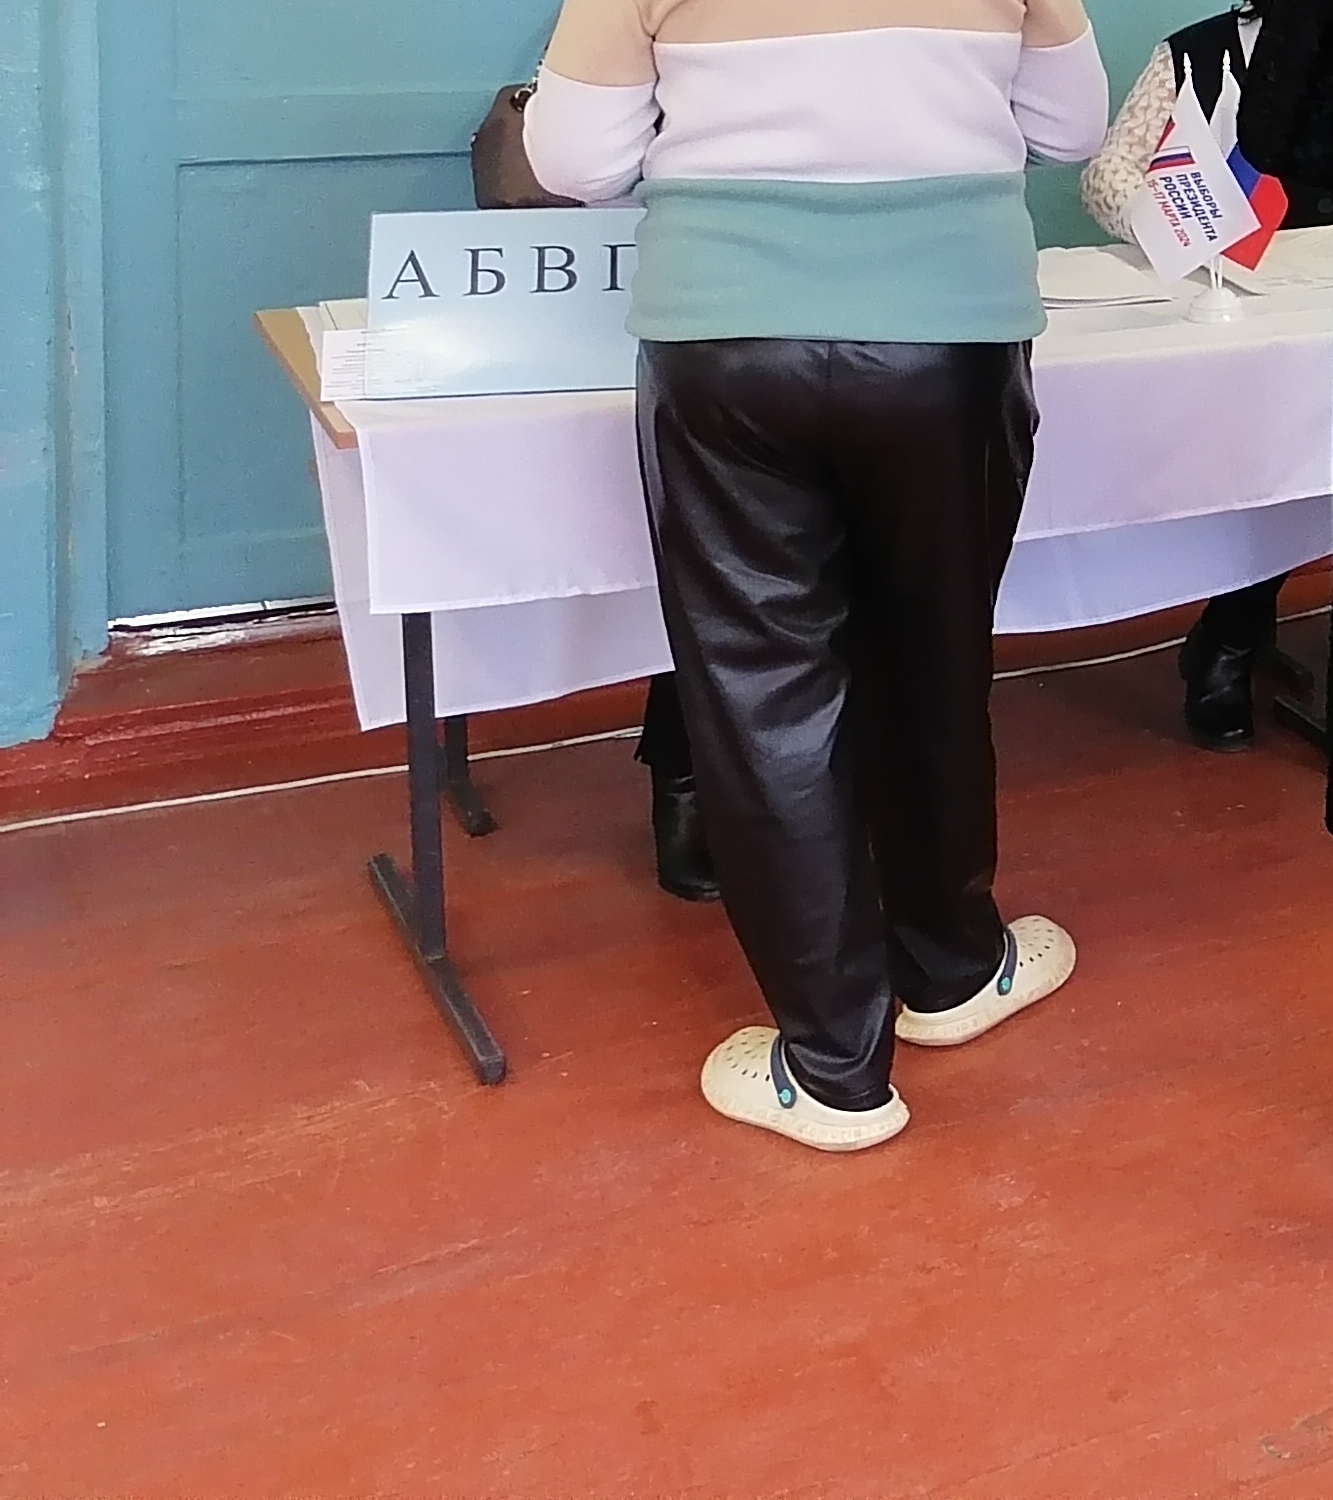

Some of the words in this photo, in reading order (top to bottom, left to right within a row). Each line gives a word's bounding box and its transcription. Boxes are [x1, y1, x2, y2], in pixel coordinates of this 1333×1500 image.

[1159, 176, 1192, 219] РОССИИ
[1176, 174, 1218, 241] ПРЕЗИДЕНТА
[1191, 172, 1223, 218] ВЫБОРЫ
[1158, 201, 1180, 227] МАРТА
[1174, 228, 1191, 247] 2024
